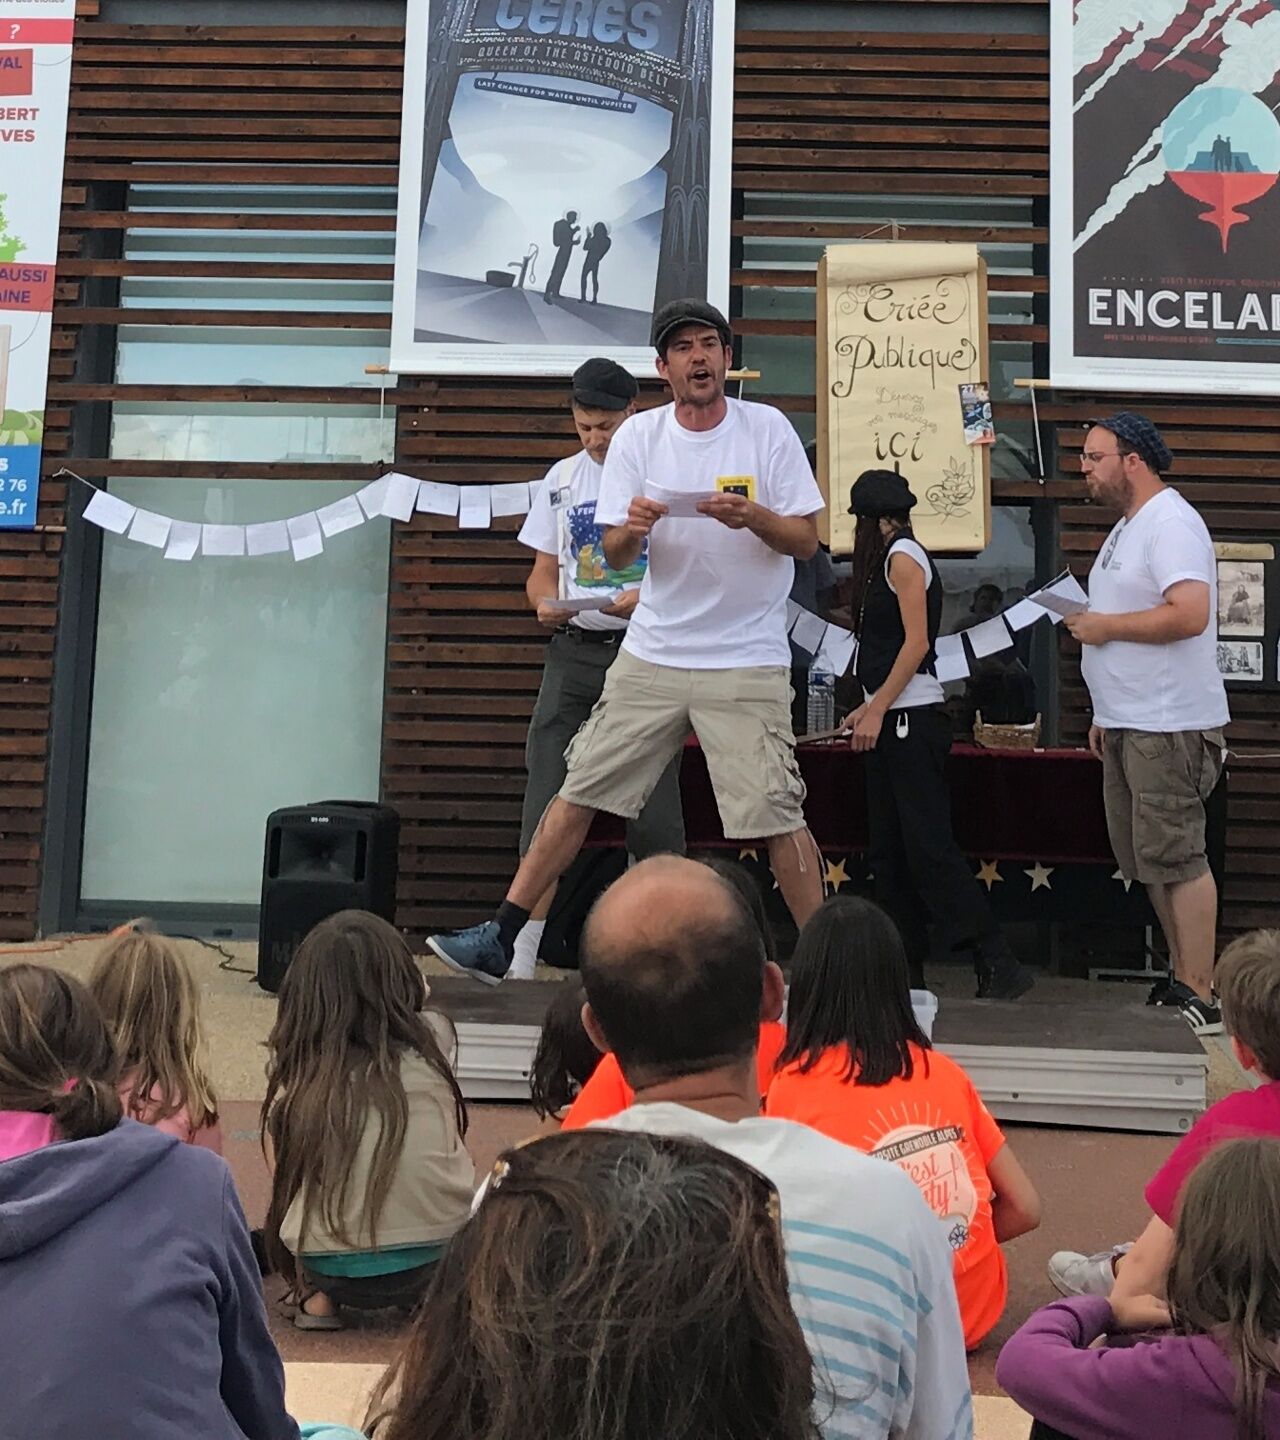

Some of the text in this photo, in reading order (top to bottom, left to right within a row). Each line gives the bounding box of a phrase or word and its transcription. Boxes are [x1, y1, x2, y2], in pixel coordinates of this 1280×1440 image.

[478, 46, 517, 57] QUEEN
[524, 47, 537, 56] OF
[546, 46, 567, 59] THE
[574, 53, 633, 73] ASTEROID
[640, 68, 668, 88] BELT
[478, 80, 632, 109] LAST CHANCE FOR WATER UNTIL JUPITER
[864, 278, 967, 324] Criée
[875, 431, 923, 462] ici
[8, 479, 27, 491] 76
[899, 1128, 957, 1154] GRENOBLE ALPES
